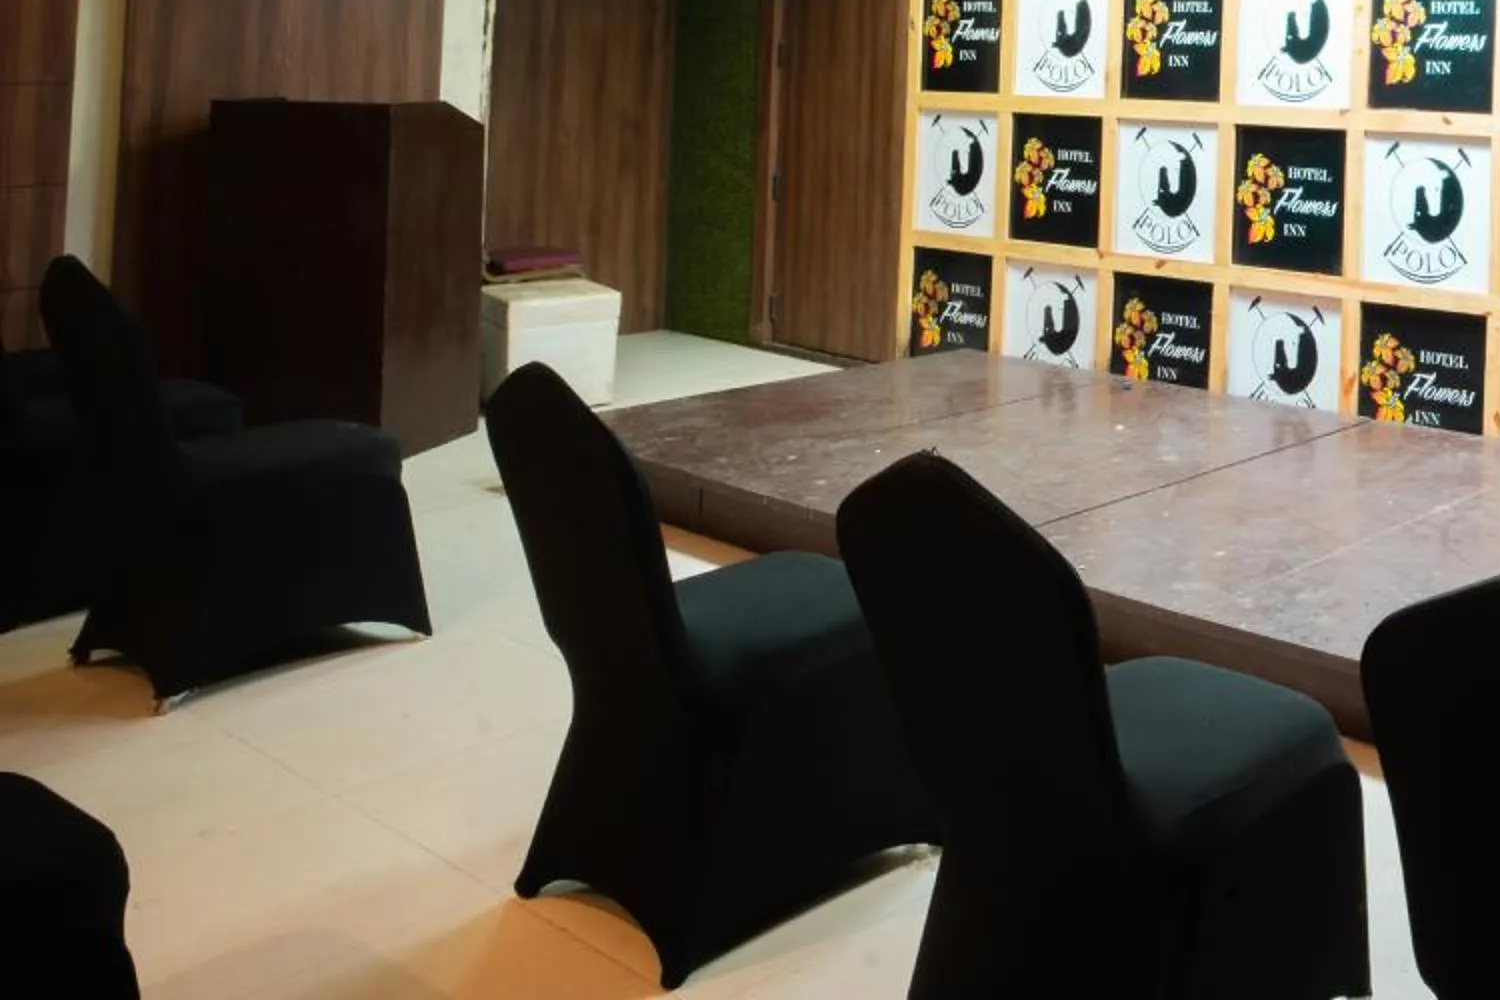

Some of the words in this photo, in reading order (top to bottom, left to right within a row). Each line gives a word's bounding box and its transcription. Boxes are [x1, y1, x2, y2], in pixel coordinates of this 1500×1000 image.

[962, 0, 997, 13] HOTEL
[1172, 0, 1213, 14] HOTEL
[1429, 0, 1481, 15] HOTEL
[951, 17, 1001, 43] Flowers
[1159, 18, 1218, 48] Flowers
[1413, 20, 1488, 54] Flowers
[959, 49, 977, 61] INN
[1168, 54, 1189, 67] INN
[1039, 58, 1088, 85] POLO
[1425, 60, 1452, 75] INN
[1265, 66, 1323, 92] POLO
[1057, 148, 1094, 164] HOTEL
[1045, 167, 1098, 195] Flowers
[1287, 166, 1332, 183] HOTEL
[1052, 199, 1073, 213] INN
[1273, 186, 1339, 217] Flowers
[1139, 219, 1191, 245] POLO
[1283, 223, 1307, 237] INN
[1391, 241, 1457, 272] POLO
[951, 283, 985, 298] HOTEL
[940, 300, 988, 328] Flowers
[1161, 311, 1201, 329] HOTEL
[946, 330, 965, 345] INN
[1147, 331, 1206, 363] Flowers
[1419, 349, 1469, 369] HOTEL
[1156, 365, 1177, 381] INN
[1403, 371, 1476, 407] Flowers
[1414, 409, 1441, 425] INN
